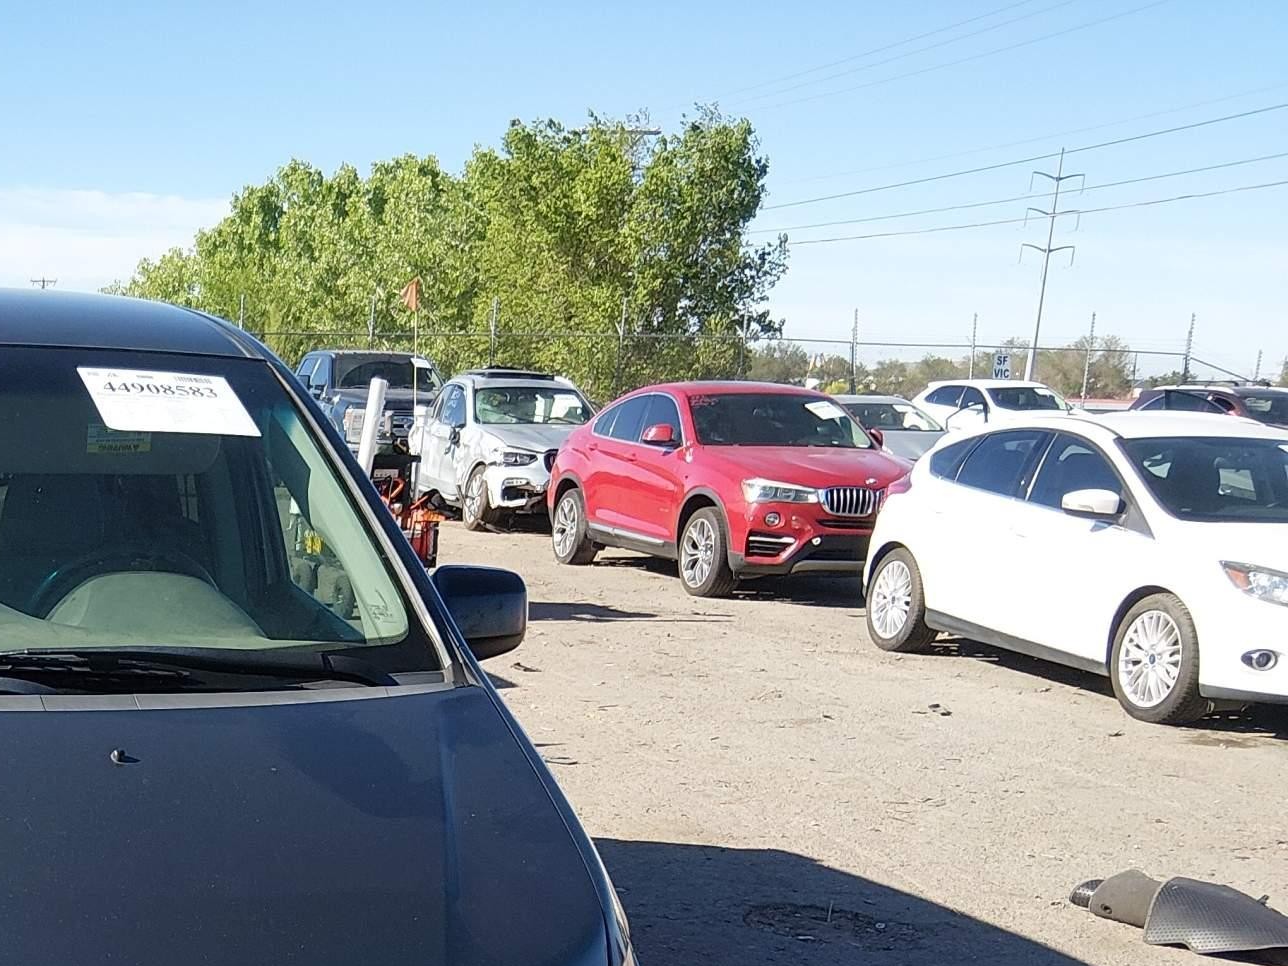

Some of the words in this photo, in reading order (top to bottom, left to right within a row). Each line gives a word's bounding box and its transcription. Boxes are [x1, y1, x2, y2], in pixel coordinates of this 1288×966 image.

[996, 355, 1009, 366] SF
[993, 368, 1010, 379] VIC
[103, 381, 219, 399] 44908583
